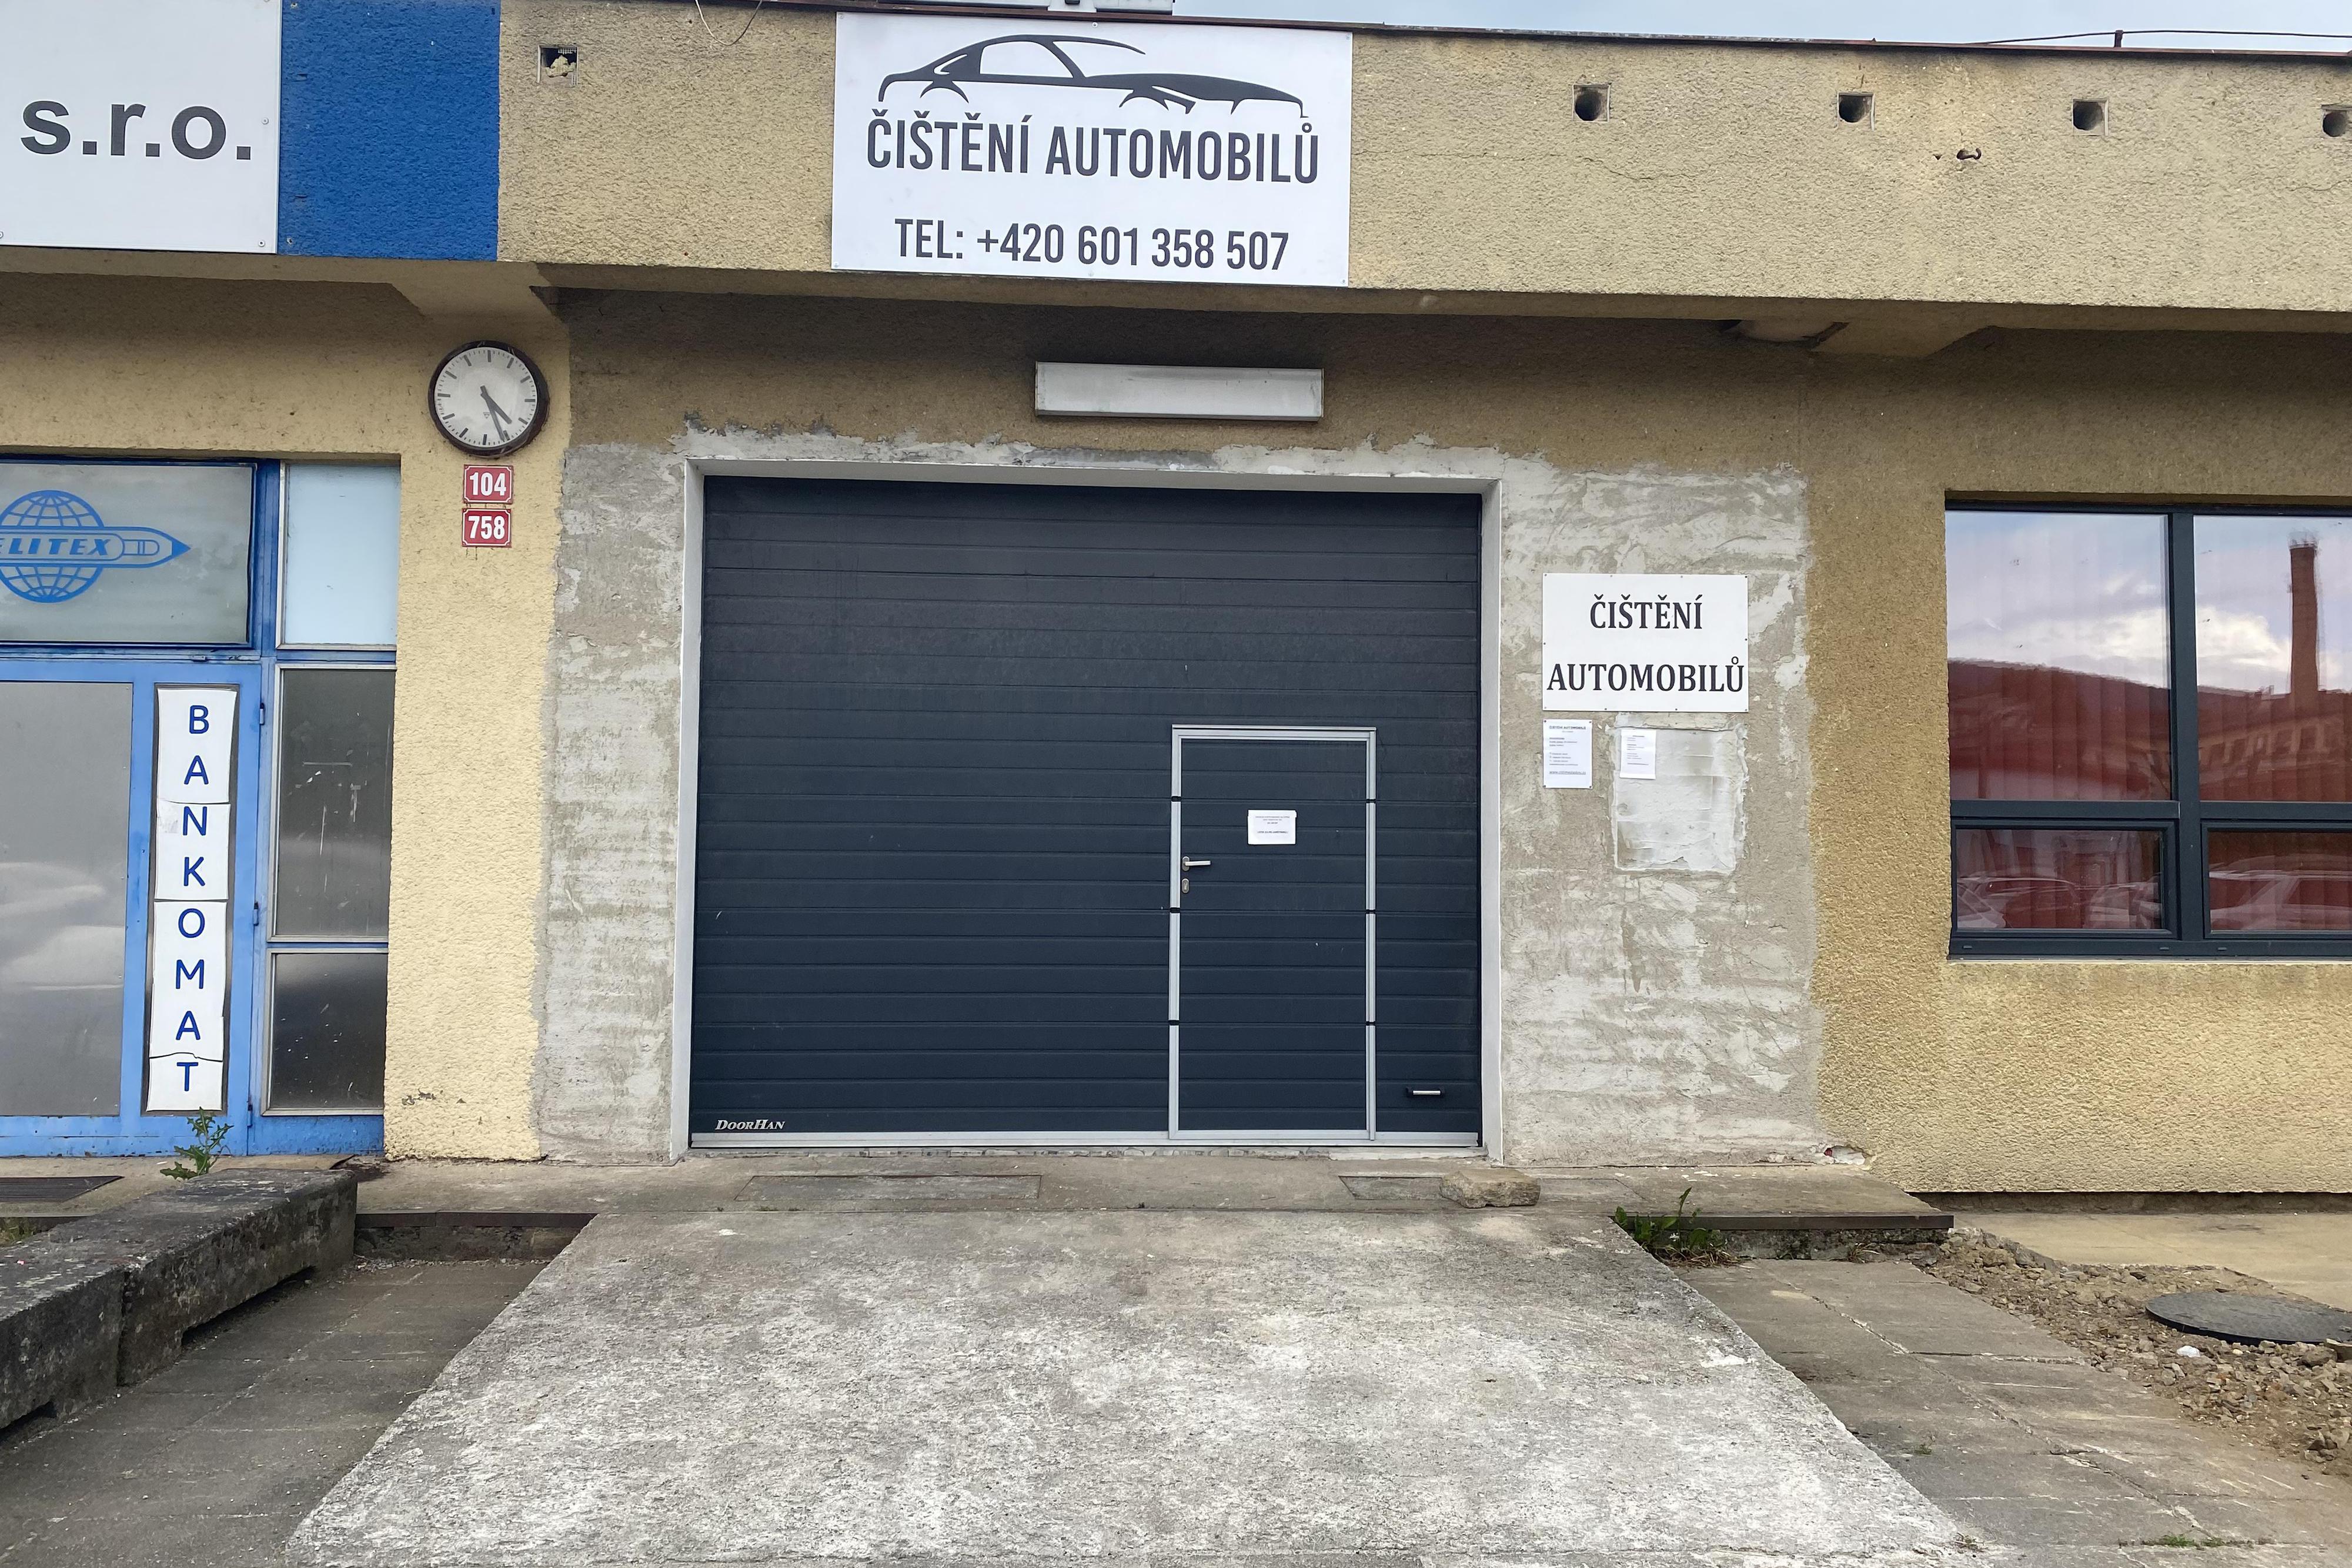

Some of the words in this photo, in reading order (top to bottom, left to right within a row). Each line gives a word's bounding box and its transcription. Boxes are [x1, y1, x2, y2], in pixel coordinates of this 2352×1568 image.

[21, 101, 251, 160] s.r.o.
[867, 108, 1033, 173] ČIŠTĚNÍ
[1045, 122, 1318, 184] AUTOMOBILŮ
[894, 218, 963, 259] TEL:
[977, 223, 1064, 263] +420
[1078, 225, 1138, 266] 601
[1151, 228, 1214, 269] 358
[1227, 230, 1289, 270] 507
[469, 472, 507, 497] 104
[467, 515, 506, 540] 758
[1590, 593, 1703, 629] ČIŠTĚNÍ
[1546, 656, 1745, 693] AUTOMOBILŮ
[175, 704, 209, 1092] BANKOMAT
